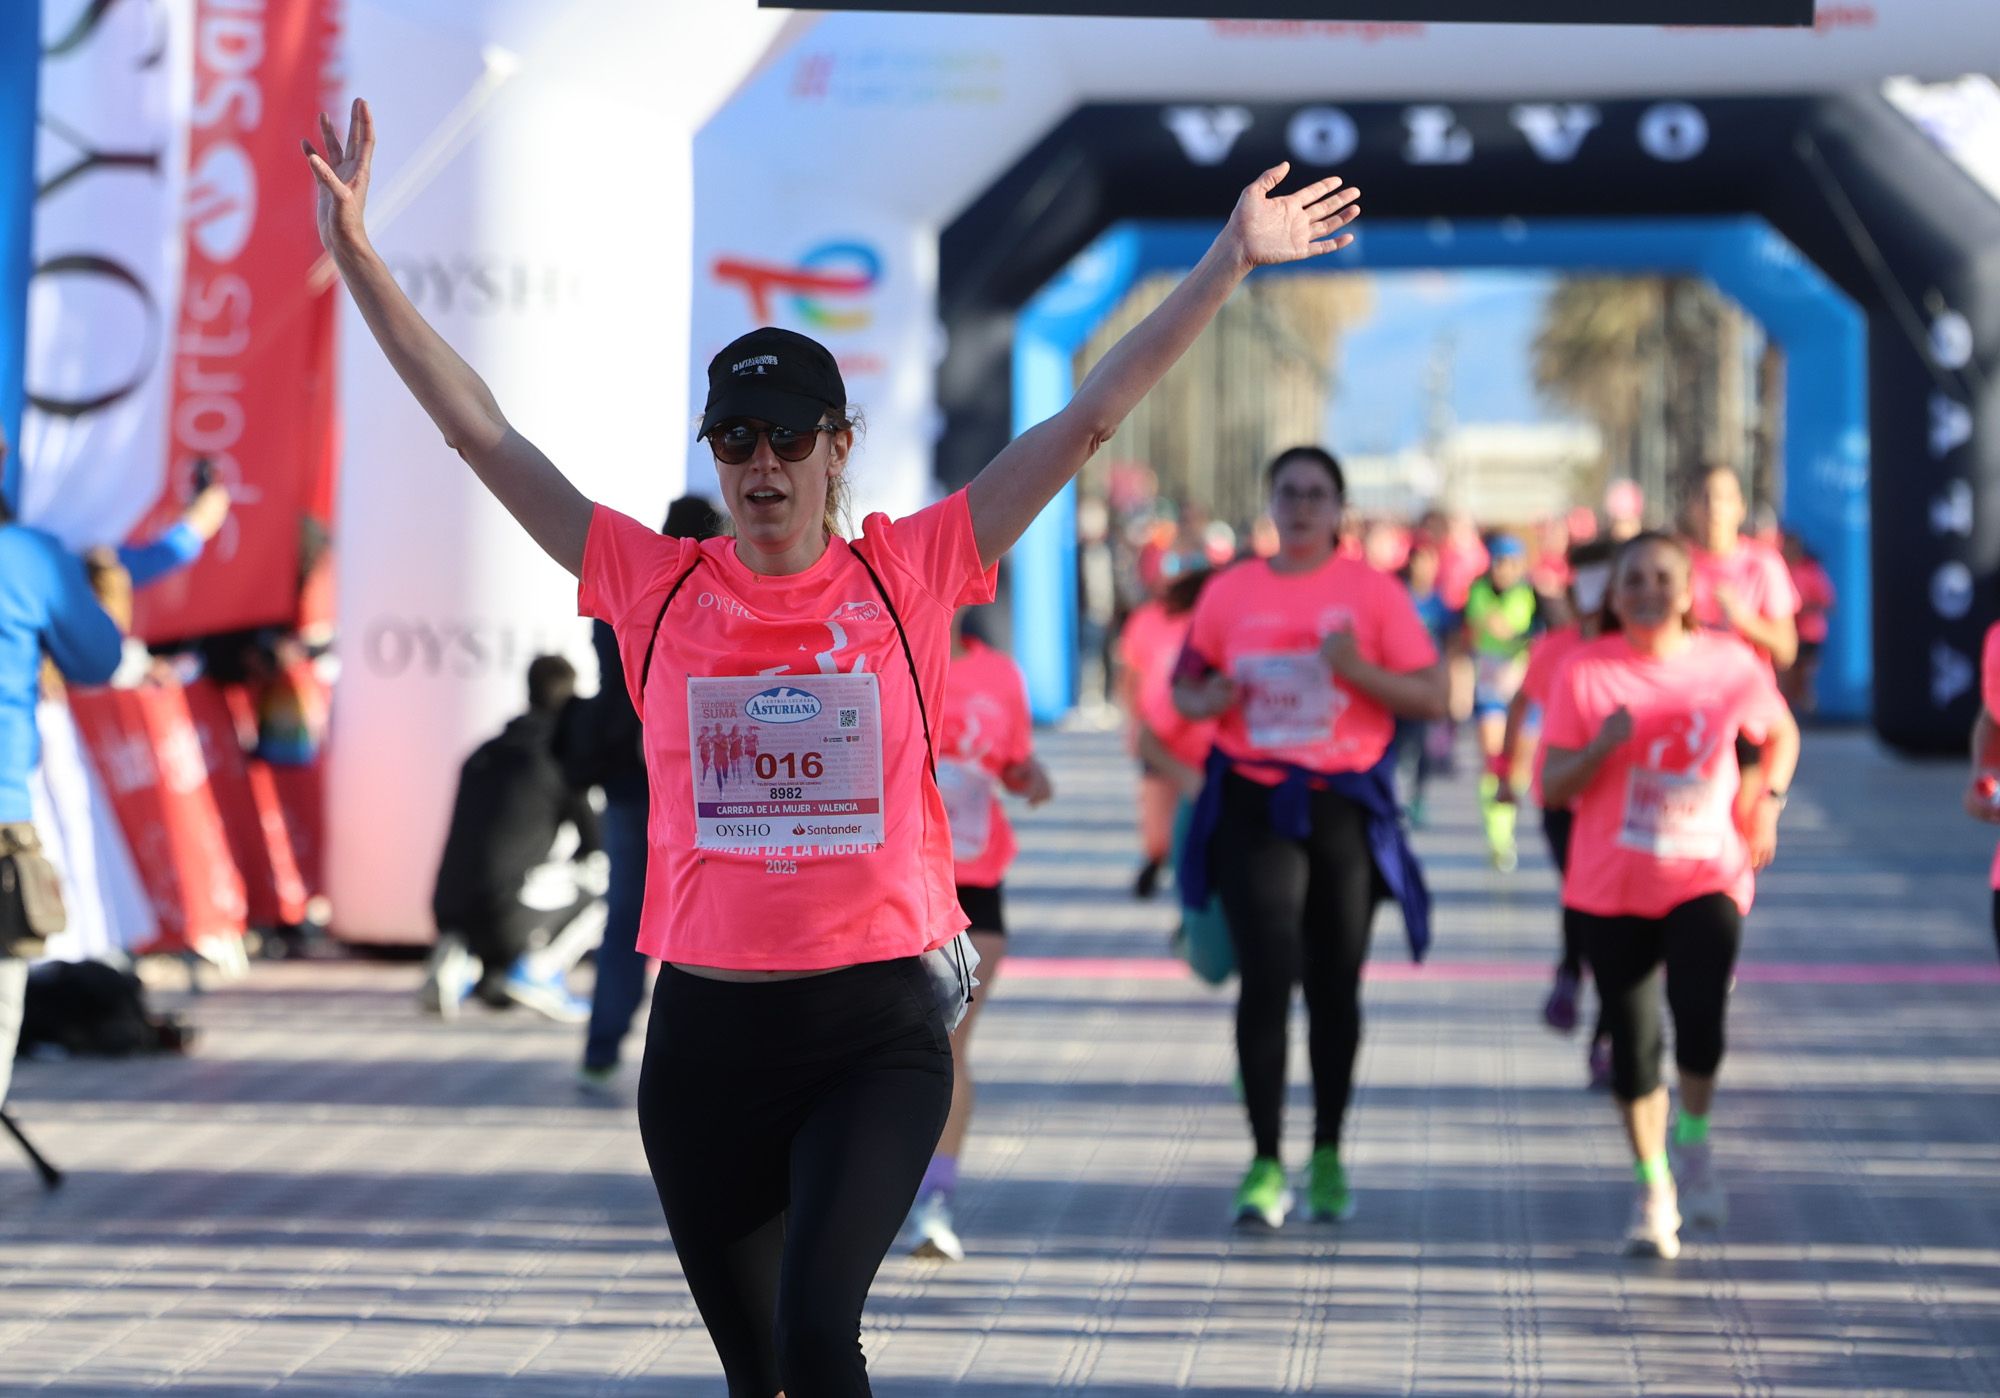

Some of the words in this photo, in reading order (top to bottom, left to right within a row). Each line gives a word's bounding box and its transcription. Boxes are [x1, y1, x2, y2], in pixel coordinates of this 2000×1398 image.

[188, 0, 267, 132] Sa
[1163, 99, 1712, 169] VOLVO
[173, 272, 262, 564] ports
[703, 709, 738, 719] SUMA
[751, 701, 816, 715] ASTURIANA
[755, 752, 824, 780] 016
[770, 787, 802, 800] 8982
[717, 805, 754, 815] CARRERA
[757, 805, 767, 814] DE
[770, 804, 781, 813] LA
[783, 803, 811, 813] MUJER
[819, 802, 858, 813] VALENCIA
[716, 824, 771, 837] OYSHO
[807, 823, 862, 836] Santander
[765, 859, 797, 875] 2025
